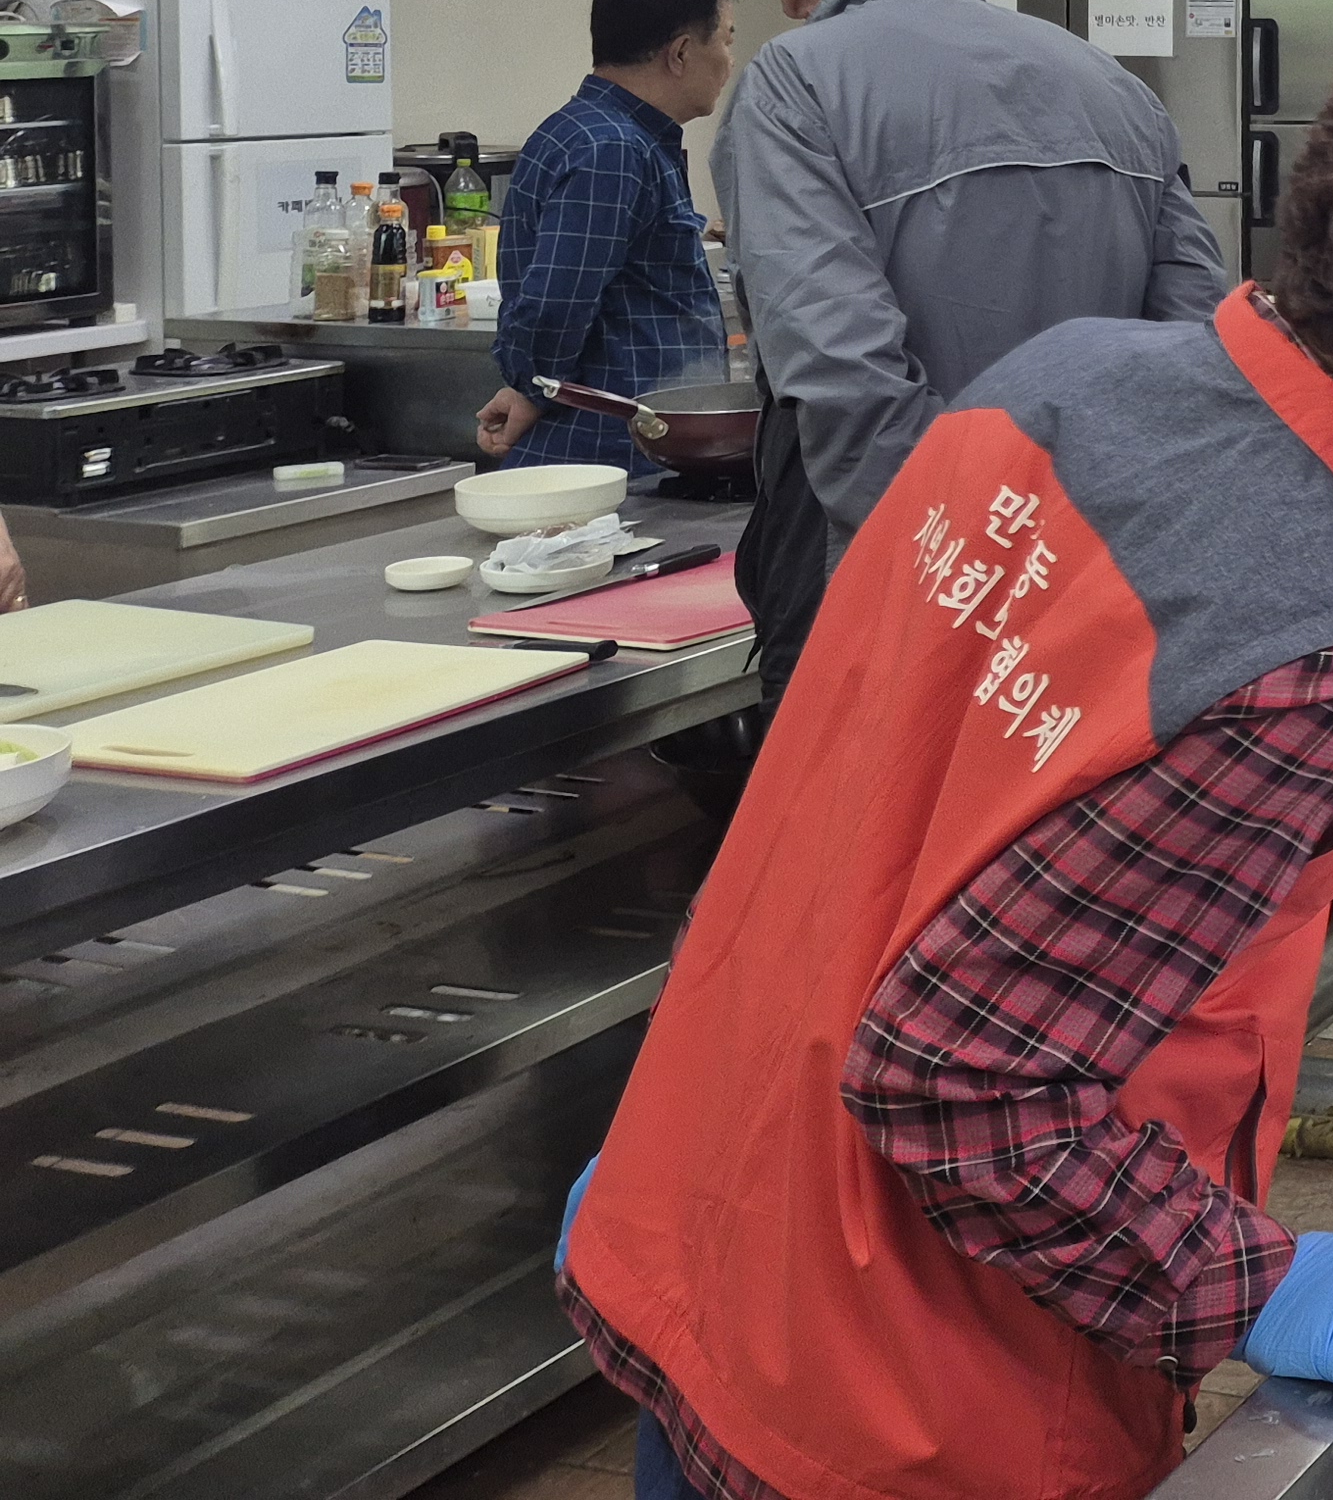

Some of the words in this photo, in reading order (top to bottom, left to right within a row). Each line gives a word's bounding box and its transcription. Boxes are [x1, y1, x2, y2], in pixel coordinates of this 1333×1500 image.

[1144, 14, 1167, 28] 반찬
[985, 484, 1060, 601] 만동
[912, 502, 1083, 774] 지역사회협의체
